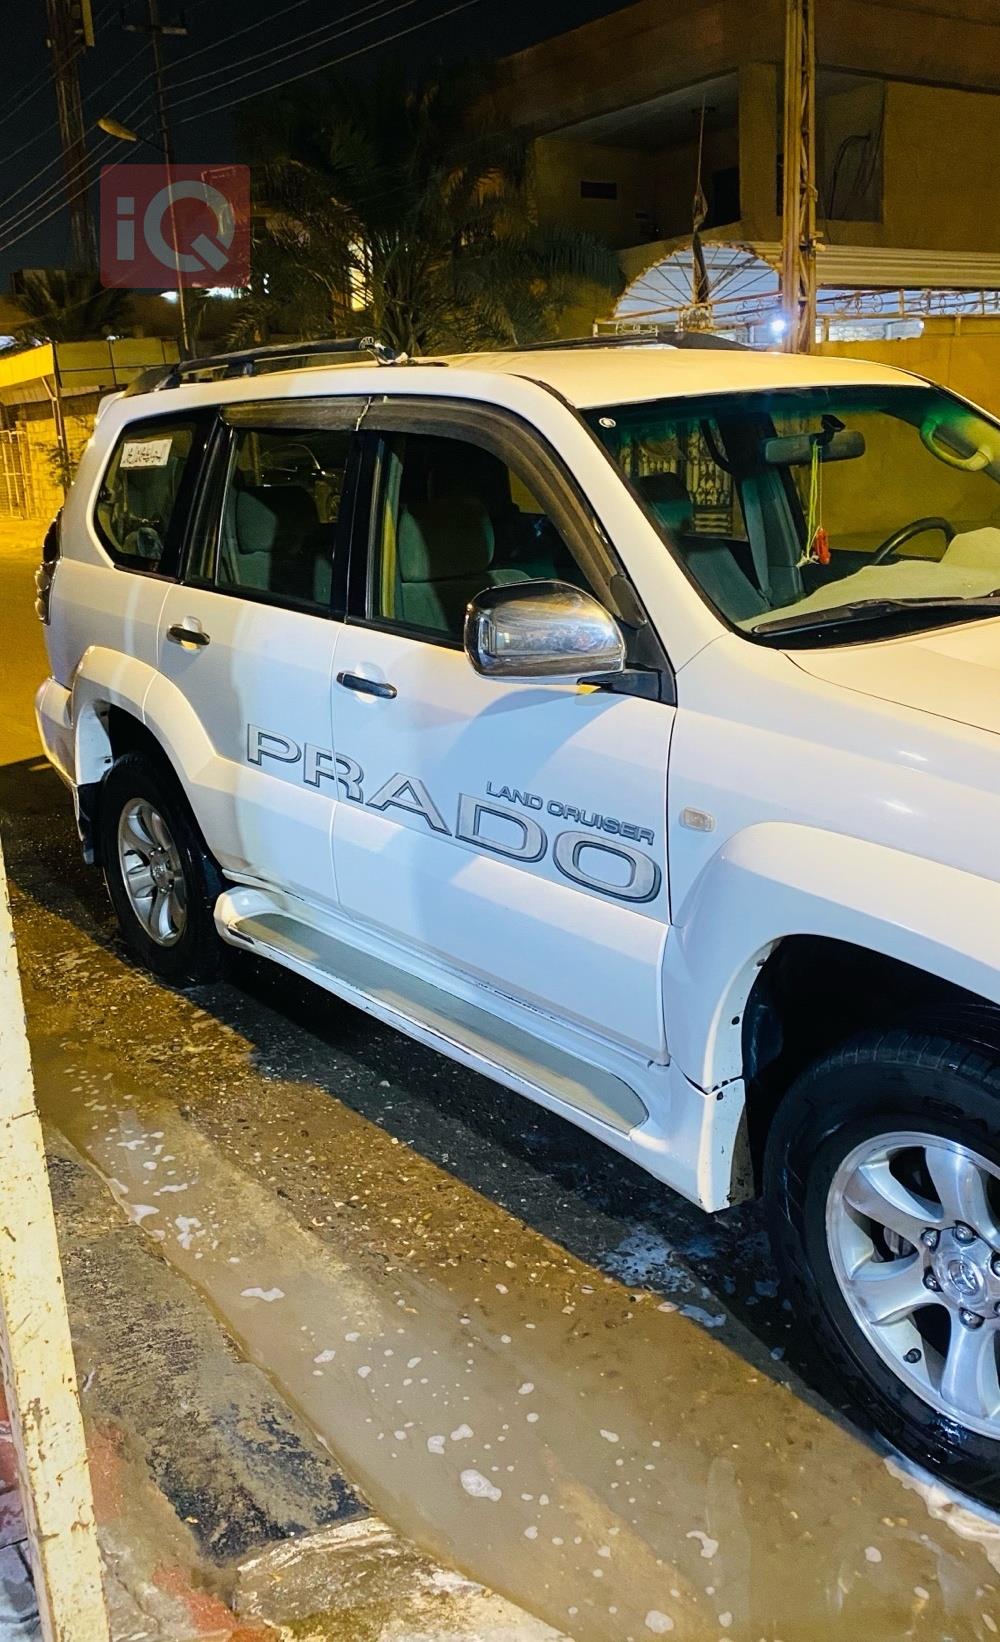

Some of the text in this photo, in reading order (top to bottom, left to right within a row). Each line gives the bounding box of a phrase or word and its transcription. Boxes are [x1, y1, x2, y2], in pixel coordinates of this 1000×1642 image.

[247, 723, 662, 903] PRADO
[486, 781, 655, 846] LAND CRUISER
